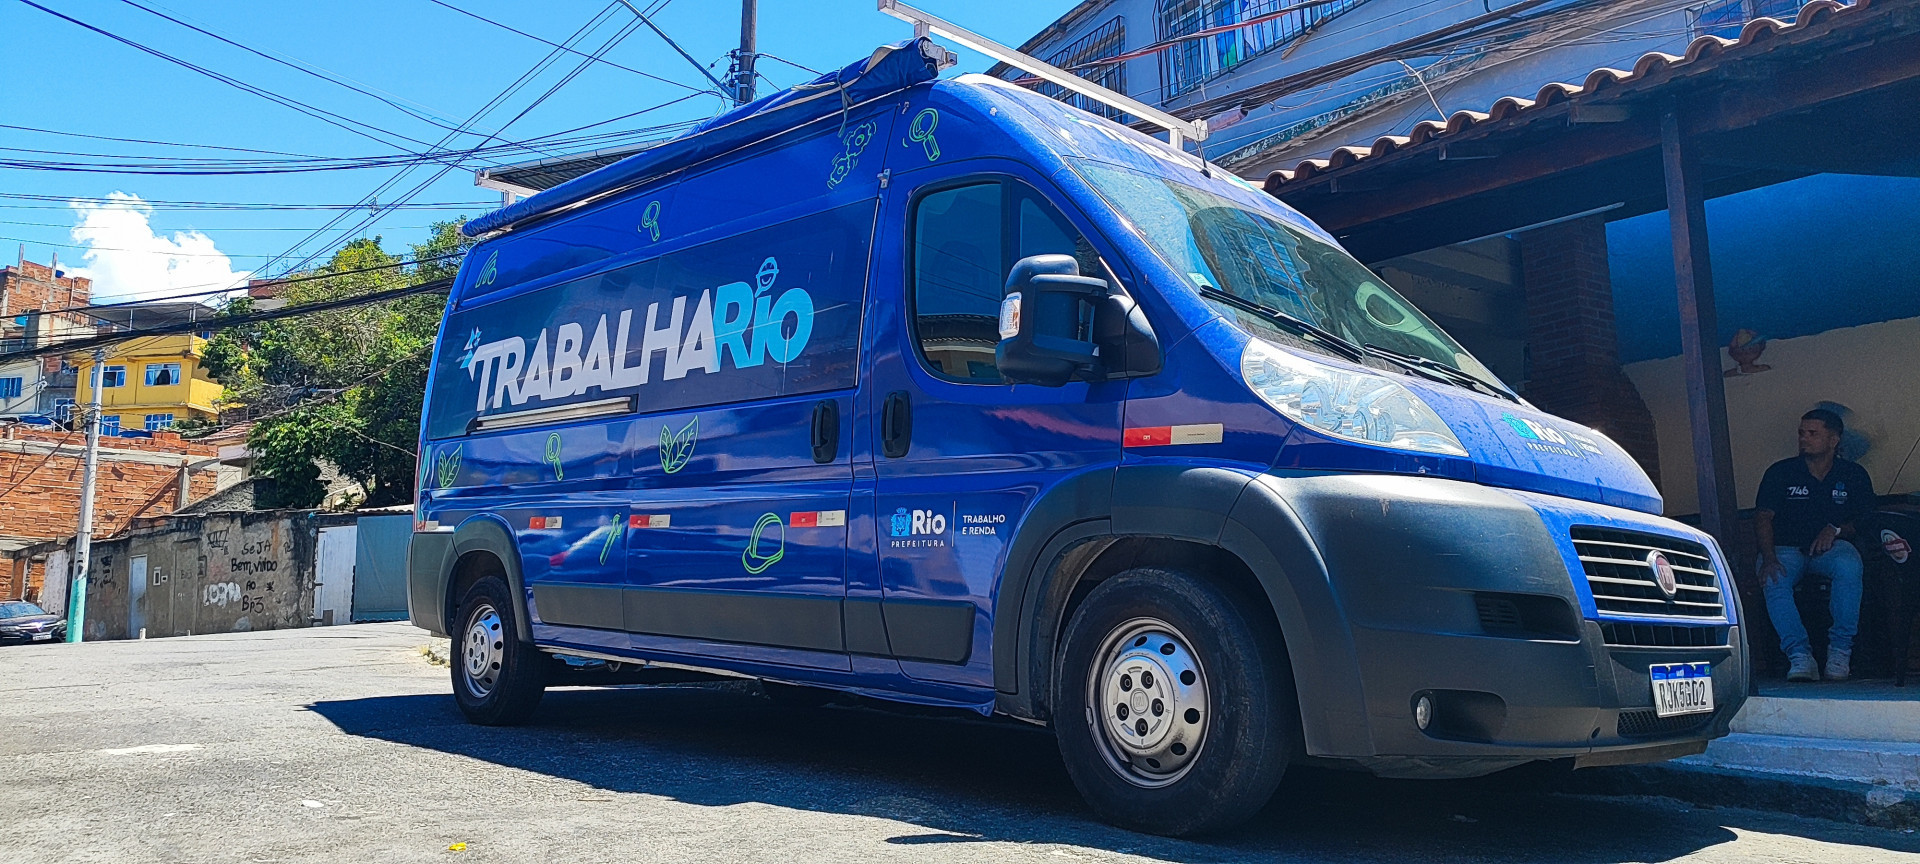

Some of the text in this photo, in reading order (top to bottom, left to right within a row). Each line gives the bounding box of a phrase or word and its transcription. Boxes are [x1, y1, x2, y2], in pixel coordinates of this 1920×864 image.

[1521, 418, 1567, 446] Rio
[1832, 489, 1848, 497] Rio
[912, 509, 946, 535] Rio
[962, 514, 1006, 524] TRABALHO
[962, 526, 996, 535] E RENDA
[891, 539, 945, 548] PREFEITURA
